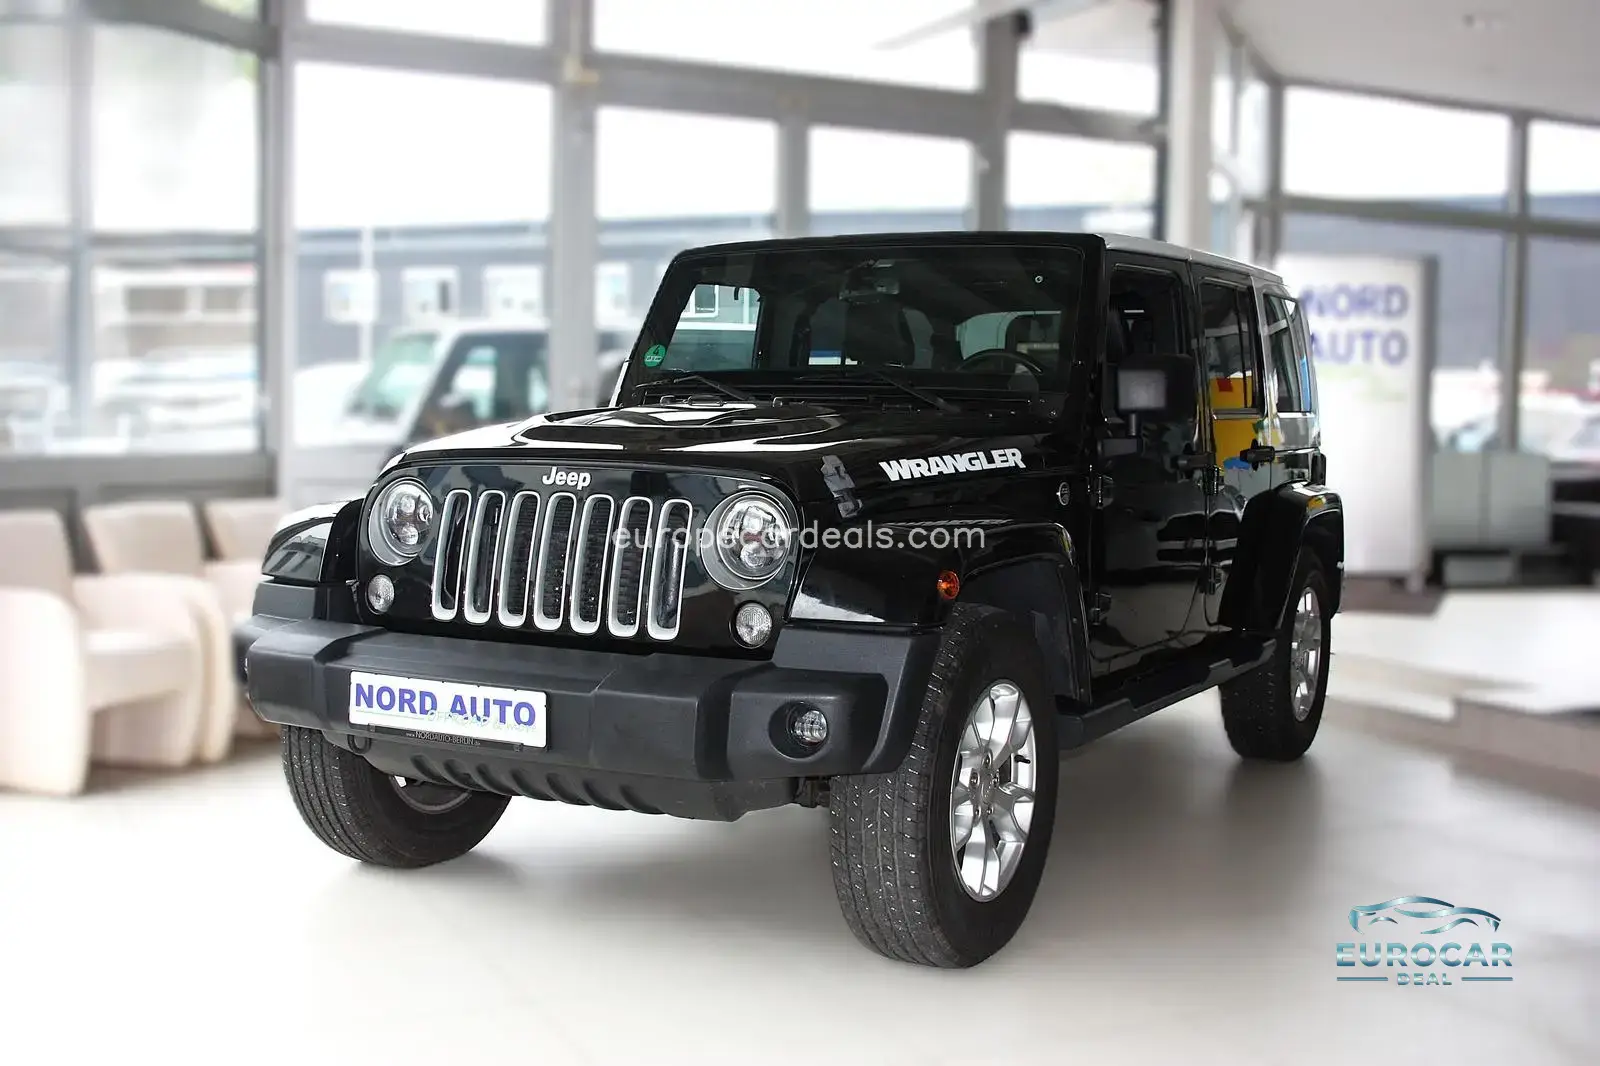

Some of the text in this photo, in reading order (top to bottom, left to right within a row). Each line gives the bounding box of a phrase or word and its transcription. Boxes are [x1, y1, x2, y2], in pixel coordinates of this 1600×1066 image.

[1301, 283, 1409, 319] NORD
[542, 466, 591, 490] Jeep
[879, 448, 1027, 481] WRANGLER
[355, 683, 536, 727] NORD AUTO
